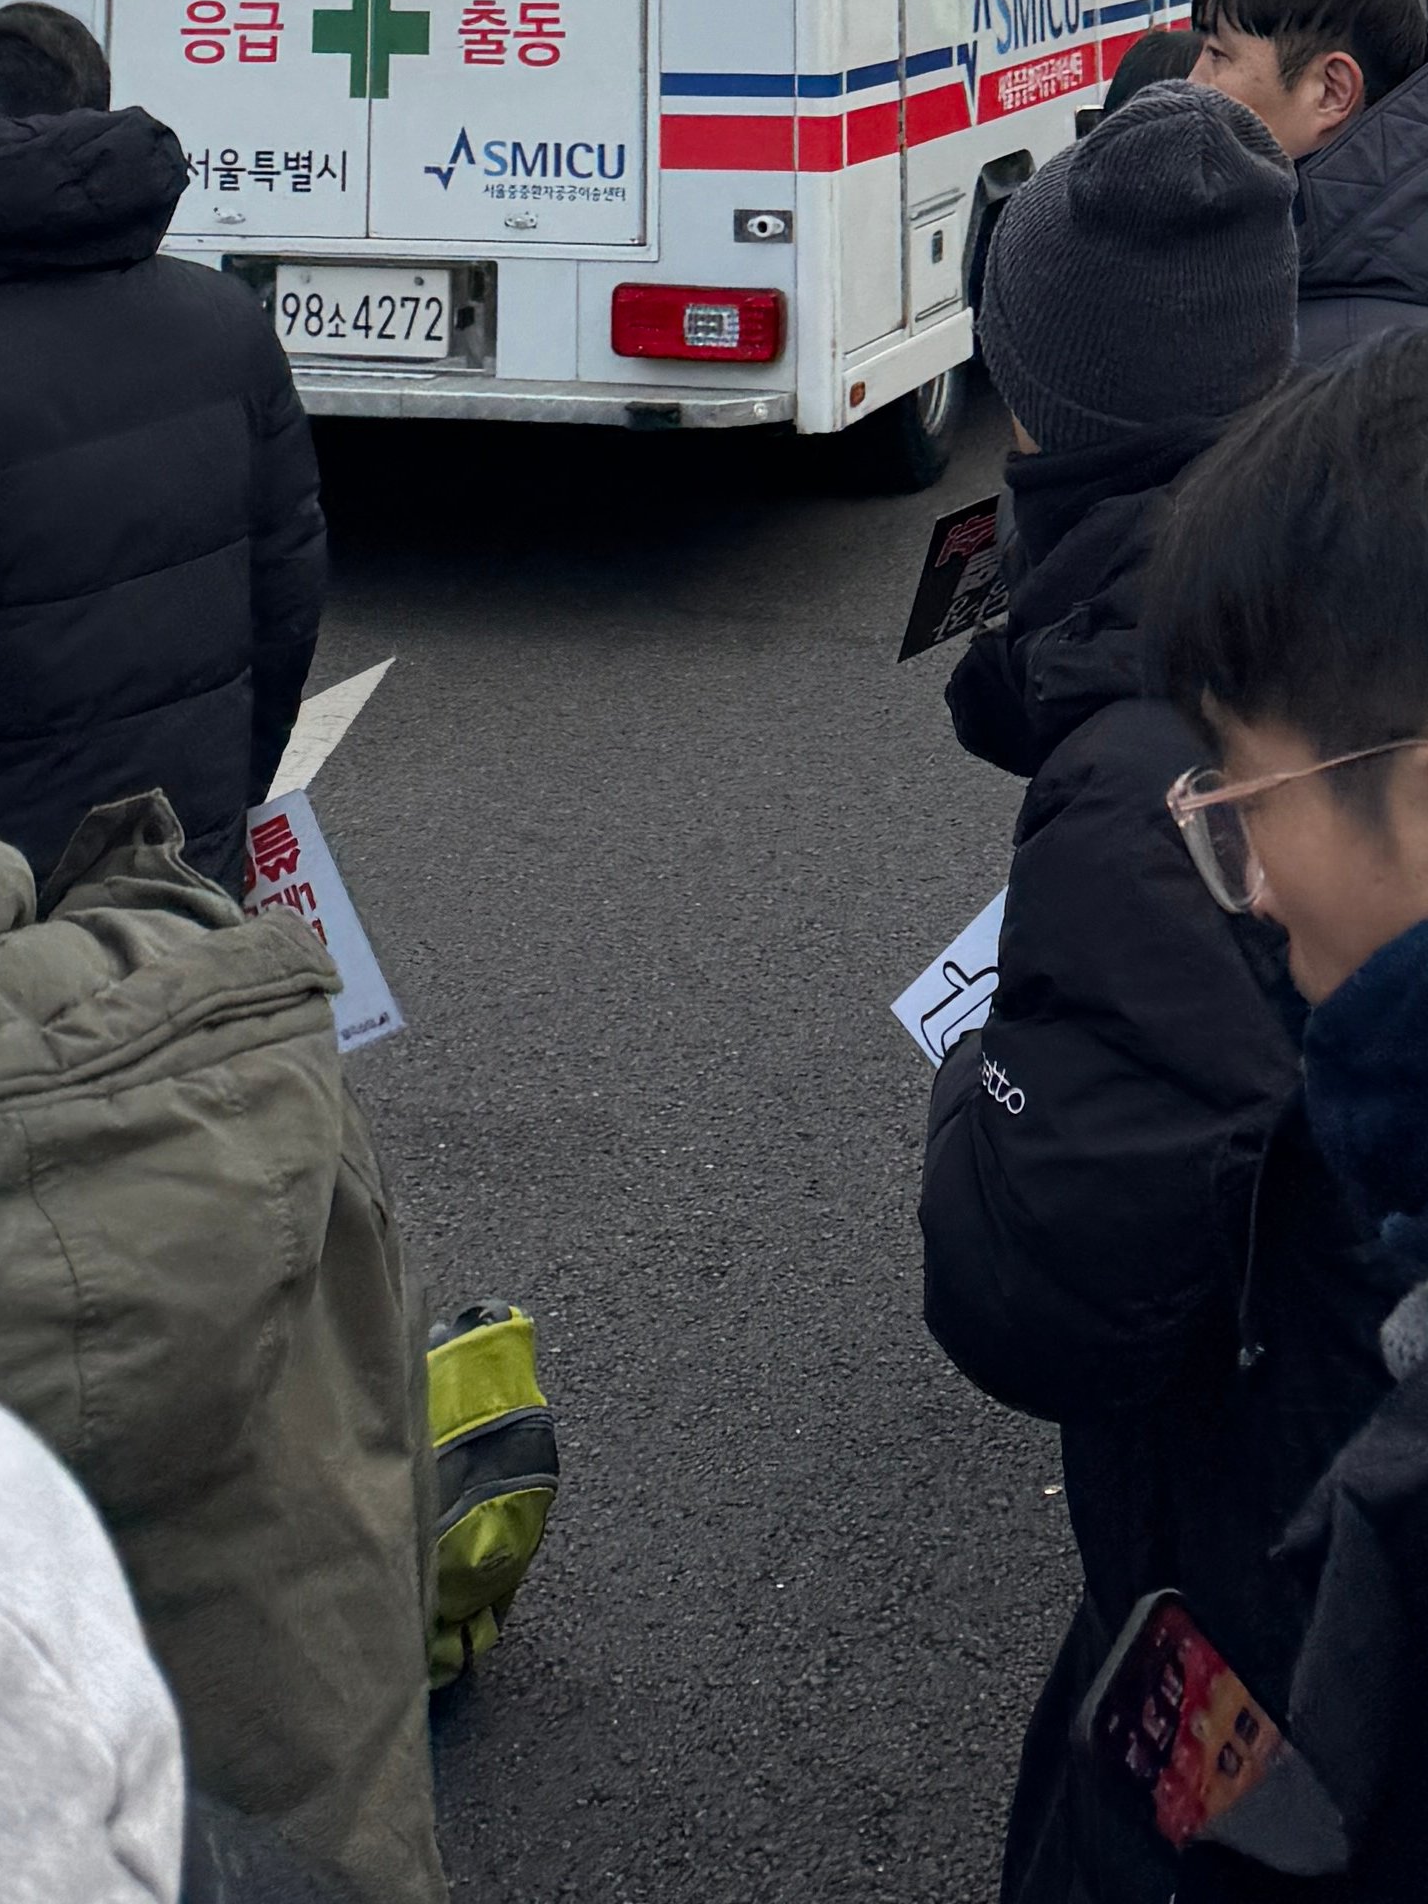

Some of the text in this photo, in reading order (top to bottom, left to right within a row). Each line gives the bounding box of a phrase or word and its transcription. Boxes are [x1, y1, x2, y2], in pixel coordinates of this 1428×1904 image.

[180, 0, 285, 64] 응급
[458, 0, 566, 67] 출동
[186, 148, 348, 192] 서울특별시
[484, 140, 626, 180] SMICU
[280, 291, 444, 342] 98소4272
